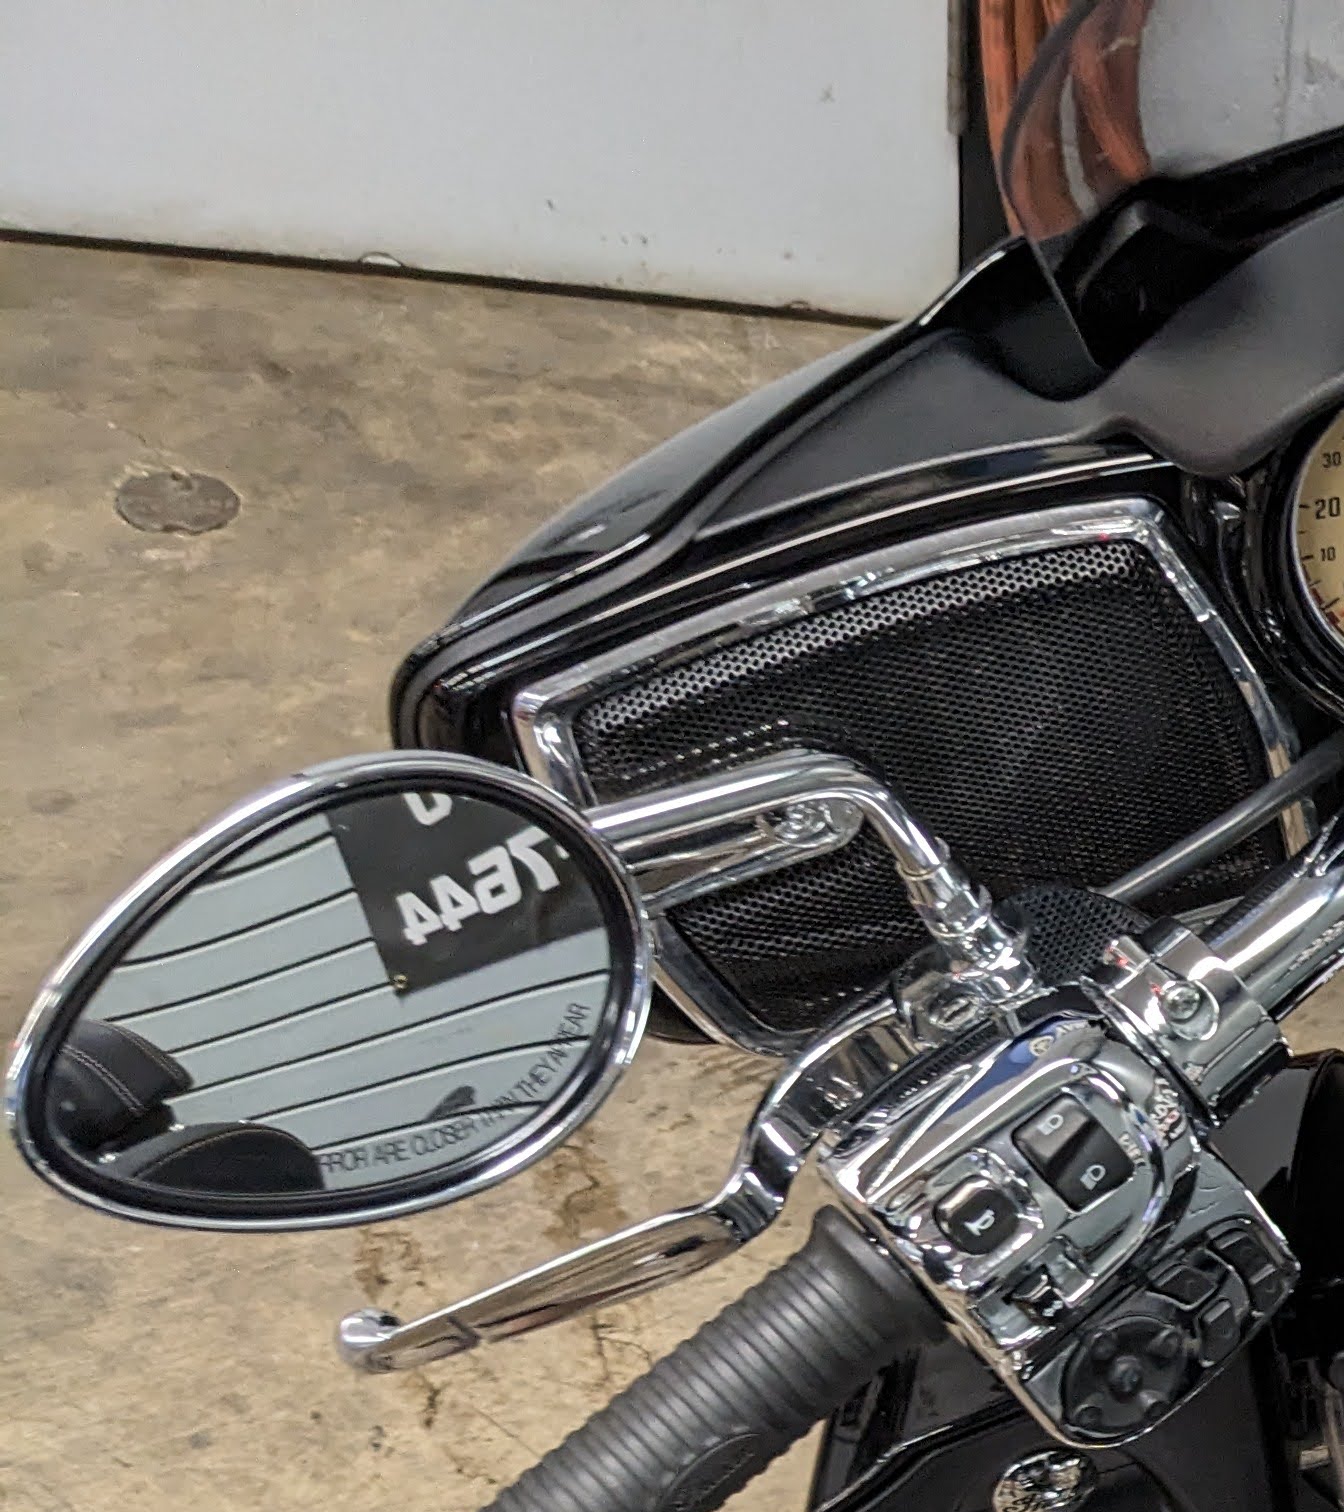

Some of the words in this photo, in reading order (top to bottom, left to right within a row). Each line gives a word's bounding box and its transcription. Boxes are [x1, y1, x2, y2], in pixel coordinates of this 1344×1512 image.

[1321, 451, 1342, 469] 30
[1314, 496, 1341, 521] 20
[1320, 547, 1337, 563] 10
